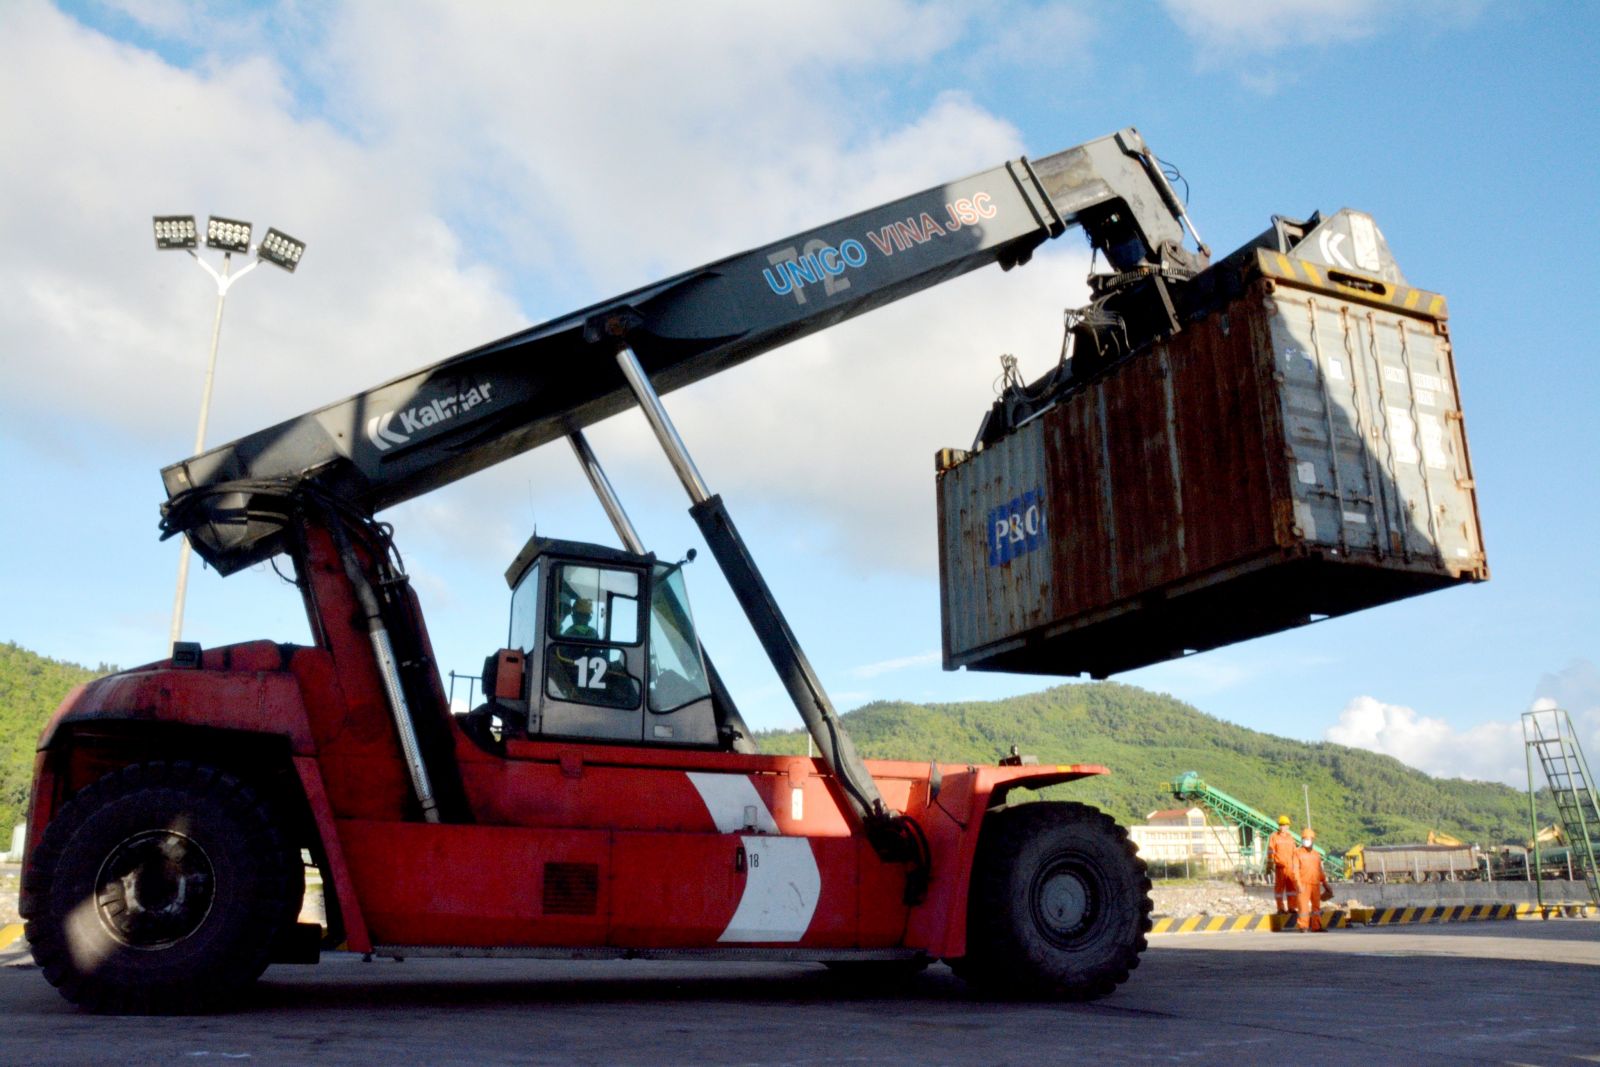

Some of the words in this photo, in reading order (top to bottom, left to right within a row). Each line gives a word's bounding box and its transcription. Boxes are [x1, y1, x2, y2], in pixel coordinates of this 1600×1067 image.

[763, 239, 868, 296] UNICO
[867, 212, 946, 257] VINA
[945, 192, 998, 232] JSC
[399, 382, 493, 435] Kalmar
[995, 504, 1040, 550] P&O
[574, 656, 608, 690] 12
[748, 853, 760, 869] 18
